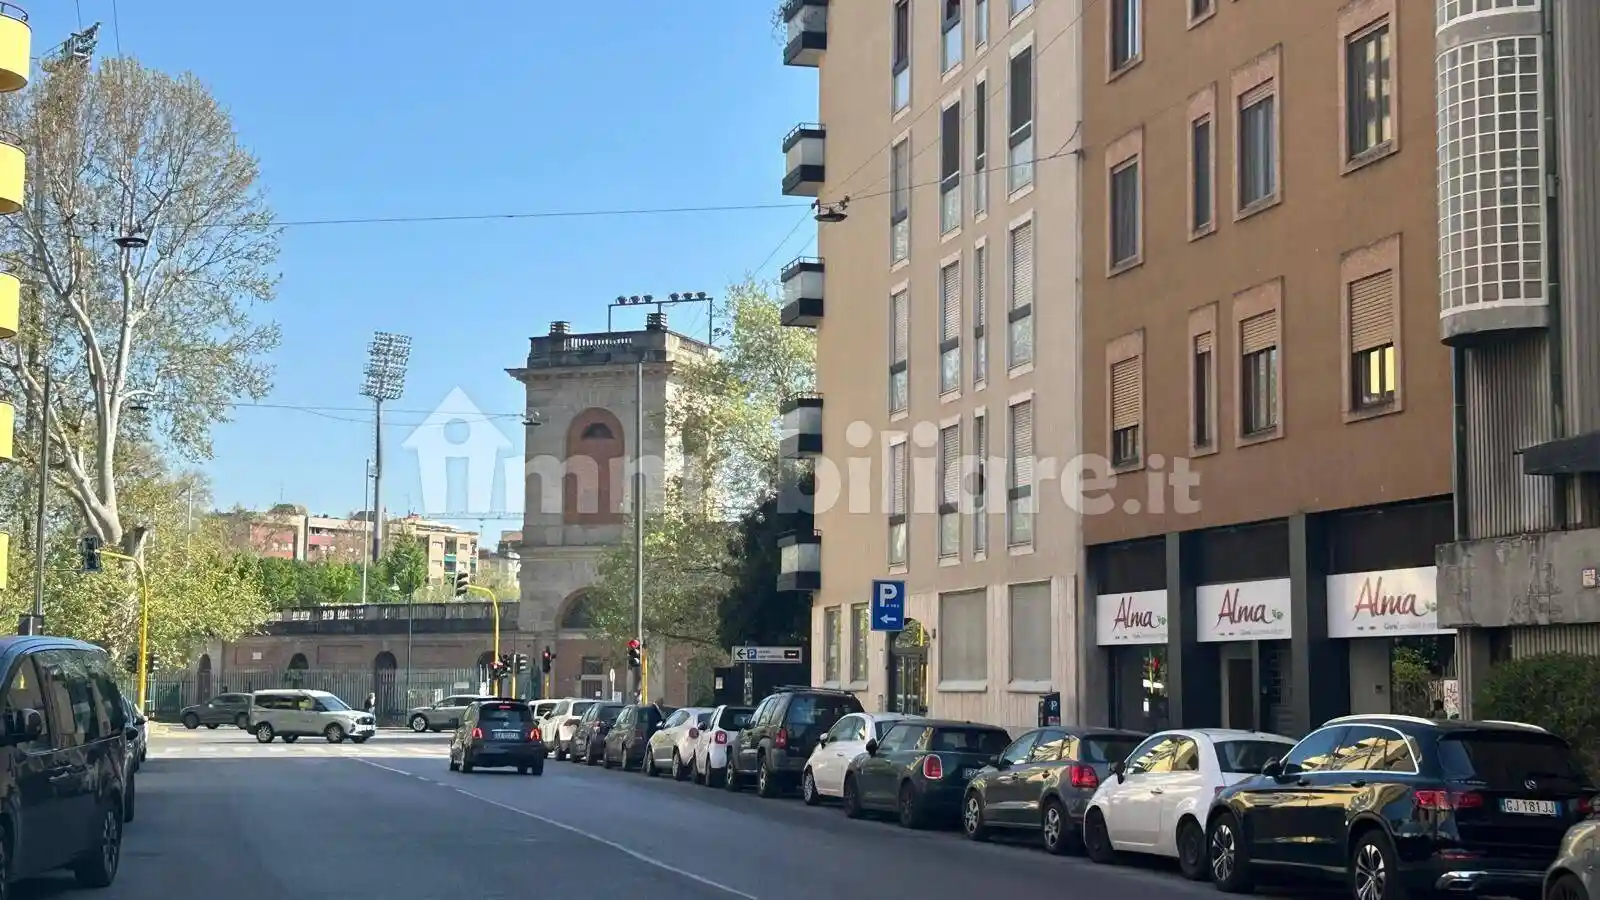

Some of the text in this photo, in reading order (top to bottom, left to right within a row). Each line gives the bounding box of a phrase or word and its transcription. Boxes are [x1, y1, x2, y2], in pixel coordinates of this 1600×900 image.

[880, 584, 897, 607] P
[1213, 588, 1271, 630] Alma
[1352, 577, 1427, 621] Alma
[1112, 596, 1158, 632] Alma
[749, 650, 756, 659] P
